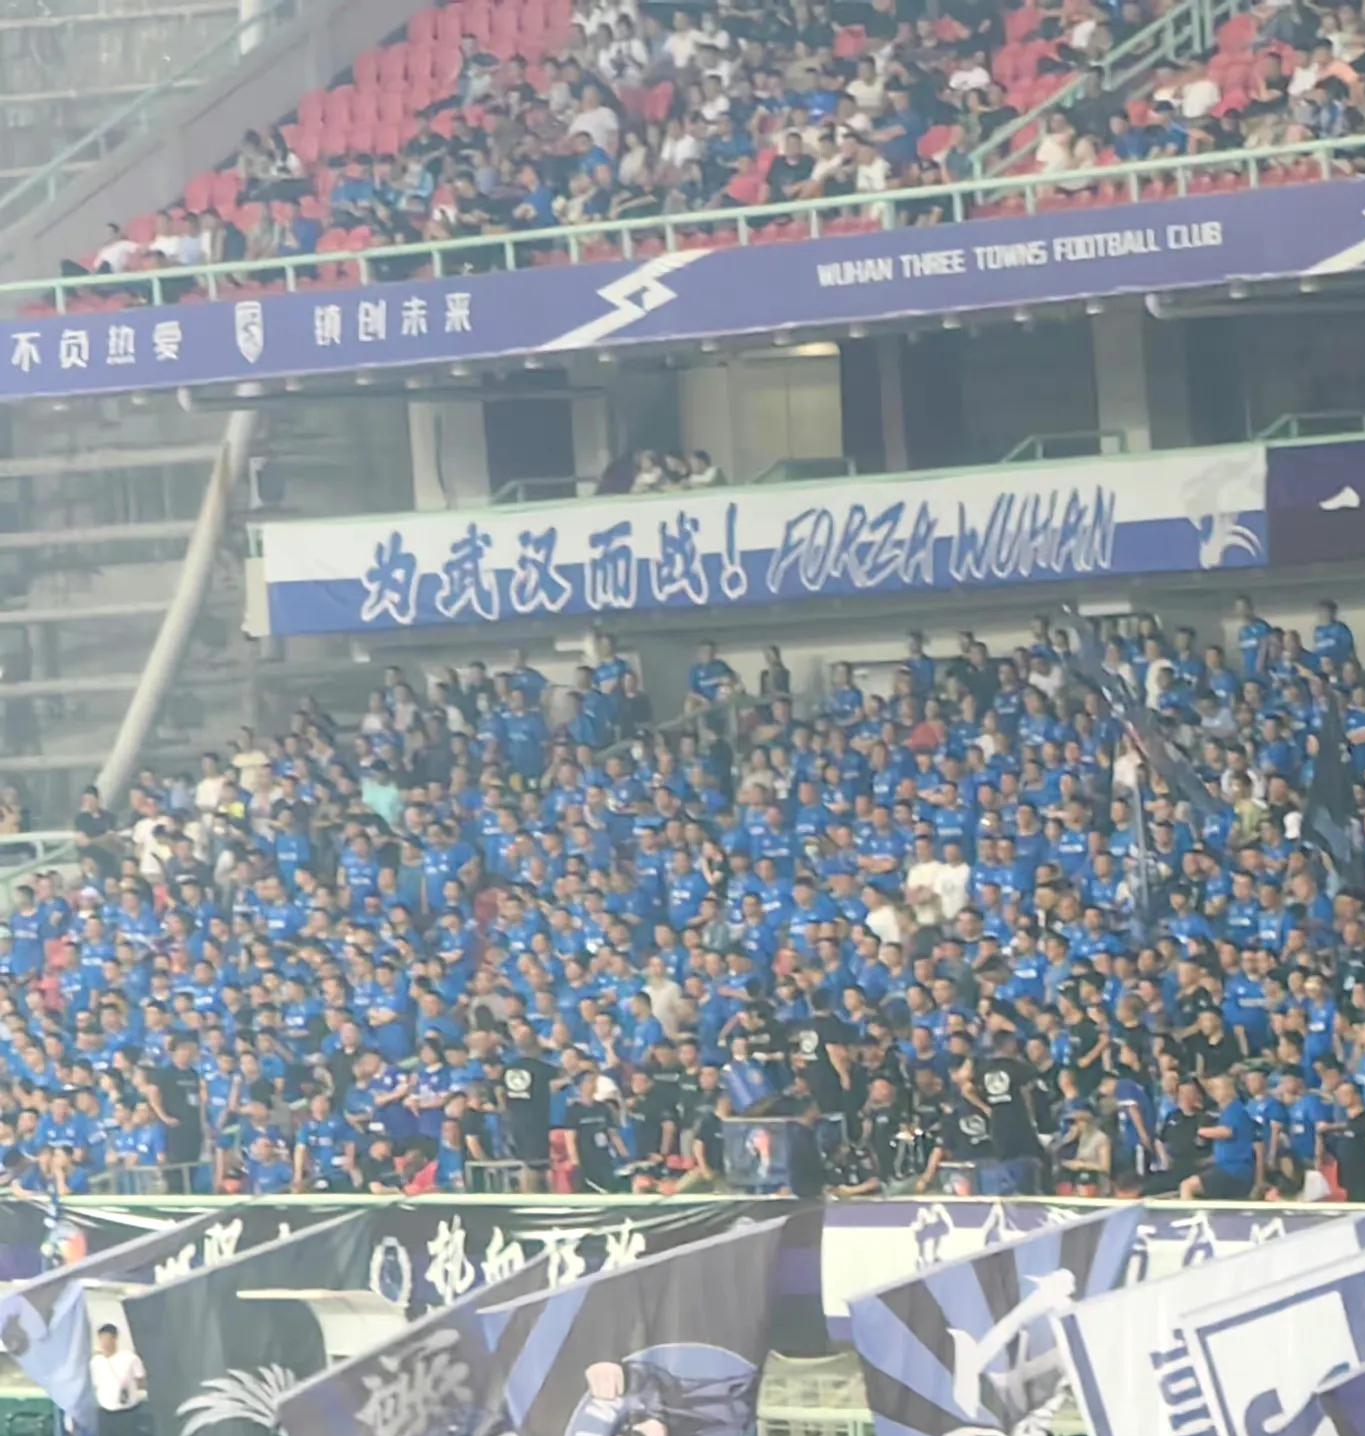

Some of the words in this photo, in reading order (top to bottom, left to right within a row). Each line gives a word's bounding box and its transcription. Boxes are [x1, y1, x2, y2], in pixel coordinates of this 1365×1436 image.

[817, 257, 894, 287] WUHAN
[901, 248, 966, 278] THREE
[975, 240, 1048, 271] TOWNS
[1054, 228, 1161, 264] FOOTBALL
[1167, 221, 1223, 252] CLUB
[11, 320, 183, 373] 不负热爱
[766, 499, 936, 595] FORZA
[950, 485, 1117, 582] WUHAN
